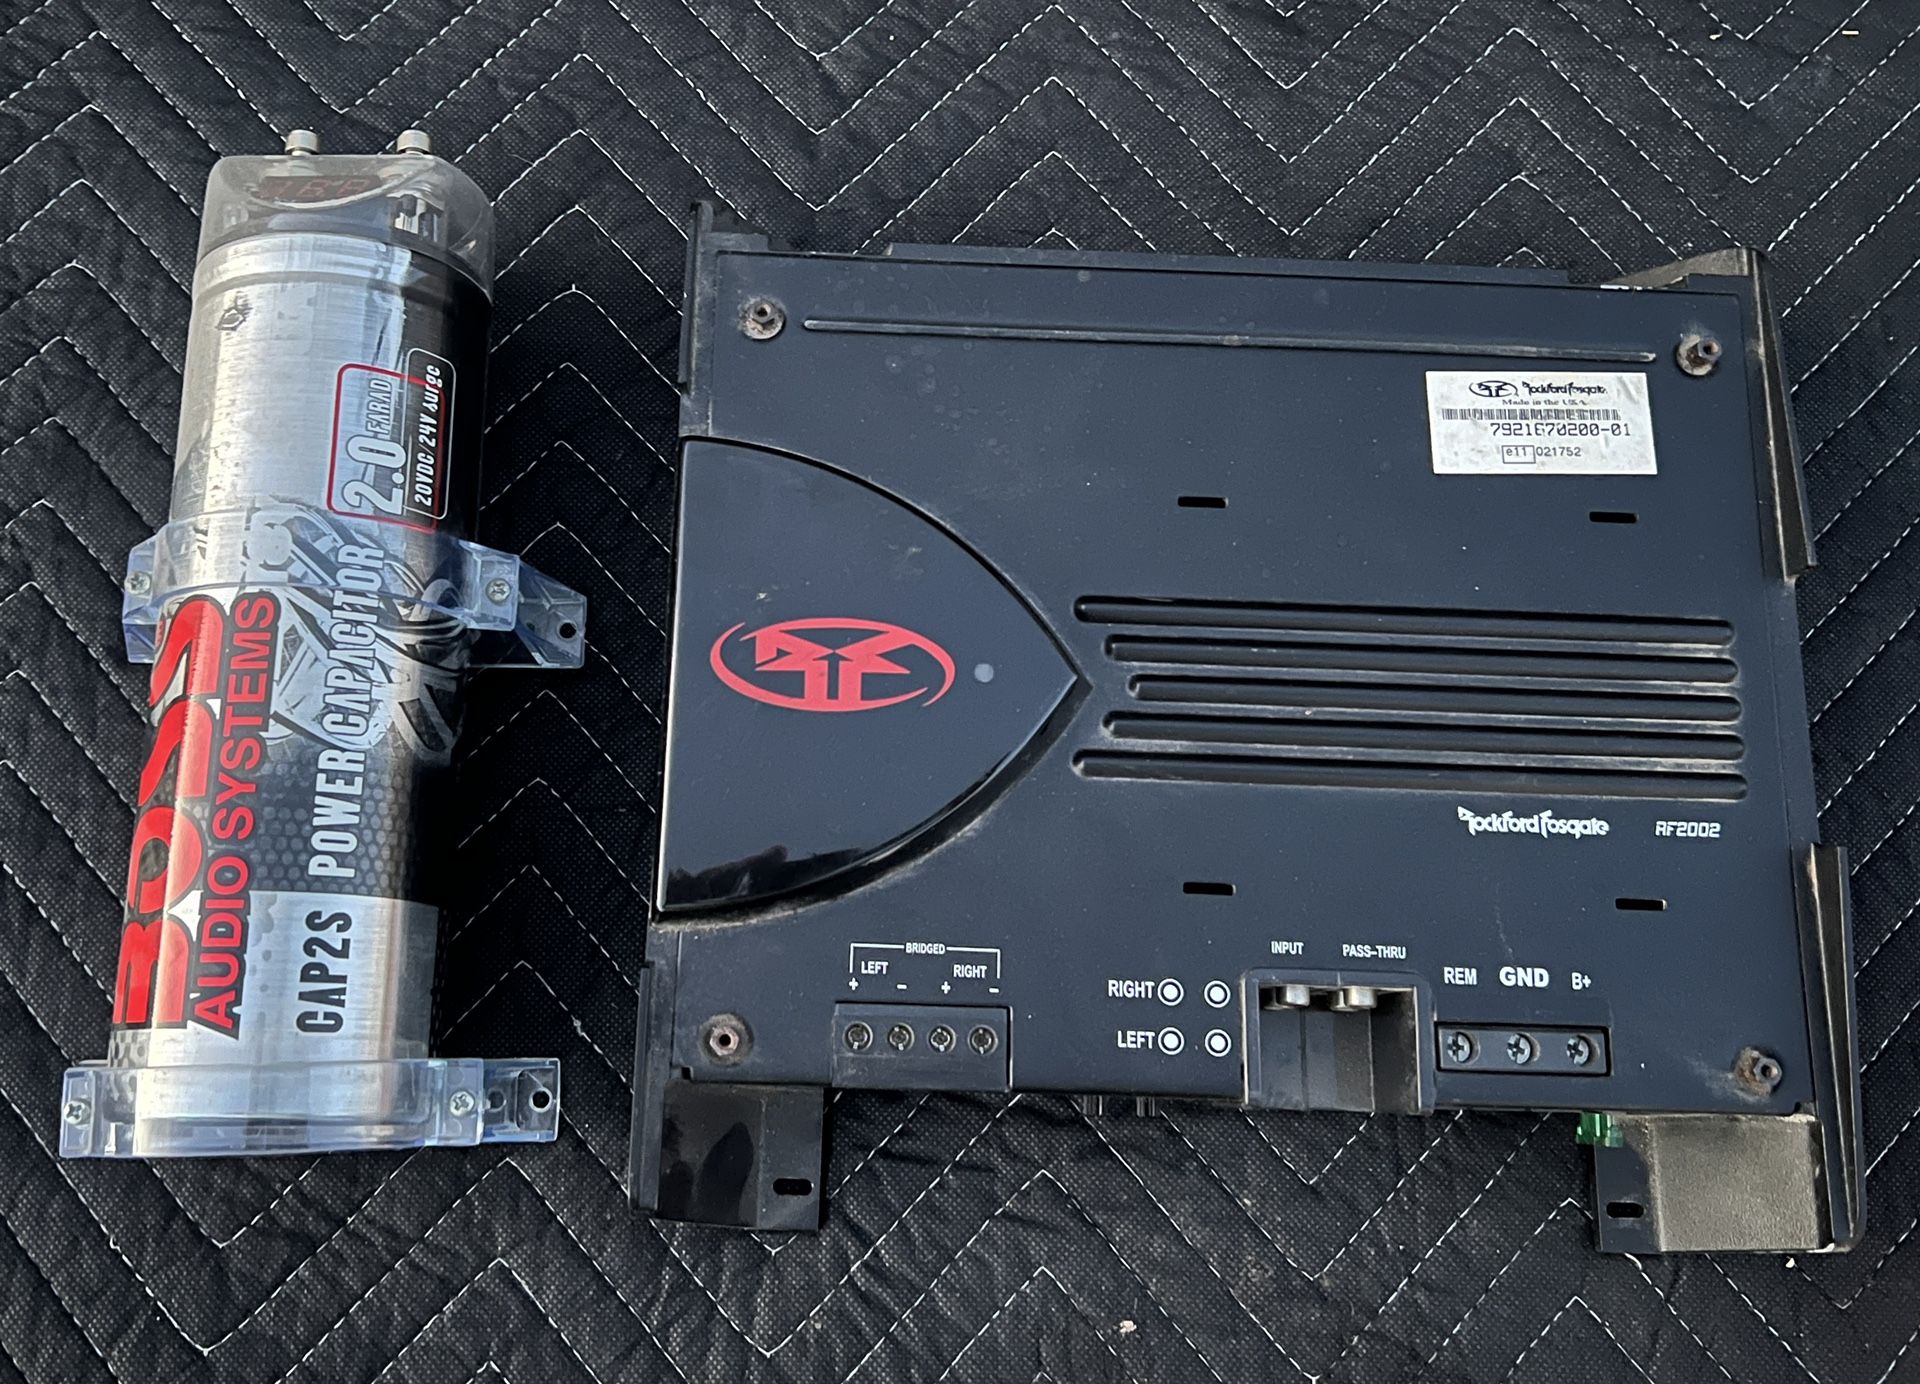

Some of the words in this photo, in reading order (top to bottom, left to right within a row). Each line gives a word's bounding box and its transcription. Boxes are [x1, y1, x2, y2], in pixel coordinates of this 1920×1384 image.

[366, 378, 393, 436] FARAD
[414, 413, 439, 507] 20VDC/24V
[1535, 446, 1582, 457] 021752
[341, 434, 407, 516] 2.0
[322, 543, 385, 738] CAPACITOR
[211, 597, 277, 840] SYSTEMS
[113, 597, 224, 1023] BOSS
[308, 748, 367, 877] POWER
[1457, 806, 1544, 836] Rockford
[1536, 809, 1610, 839] Fosgate
[1655, 821, 1721, 838] RF2002
[192, 855, 250, 1030] AUDIO
[905, 942, 946, 955] BRIDGED
[1270, 941, 1304, 955] INPUT
[1342, 943, 1406, 959] PASS-THRU
[296, 910, 352, 1034] CAP2S
[861, 961, 889, 975] LEFT
[953, 964, 988, 979] RIGHT
[1443, 967, 1478, 985] REM
[1499, 966, 1550, 988] GND
[1107, 979, 1155, 999] RIGHT
[1571, 972, 1592, 990] B+
[1116, 1030, 1155, 1049] LEFT
